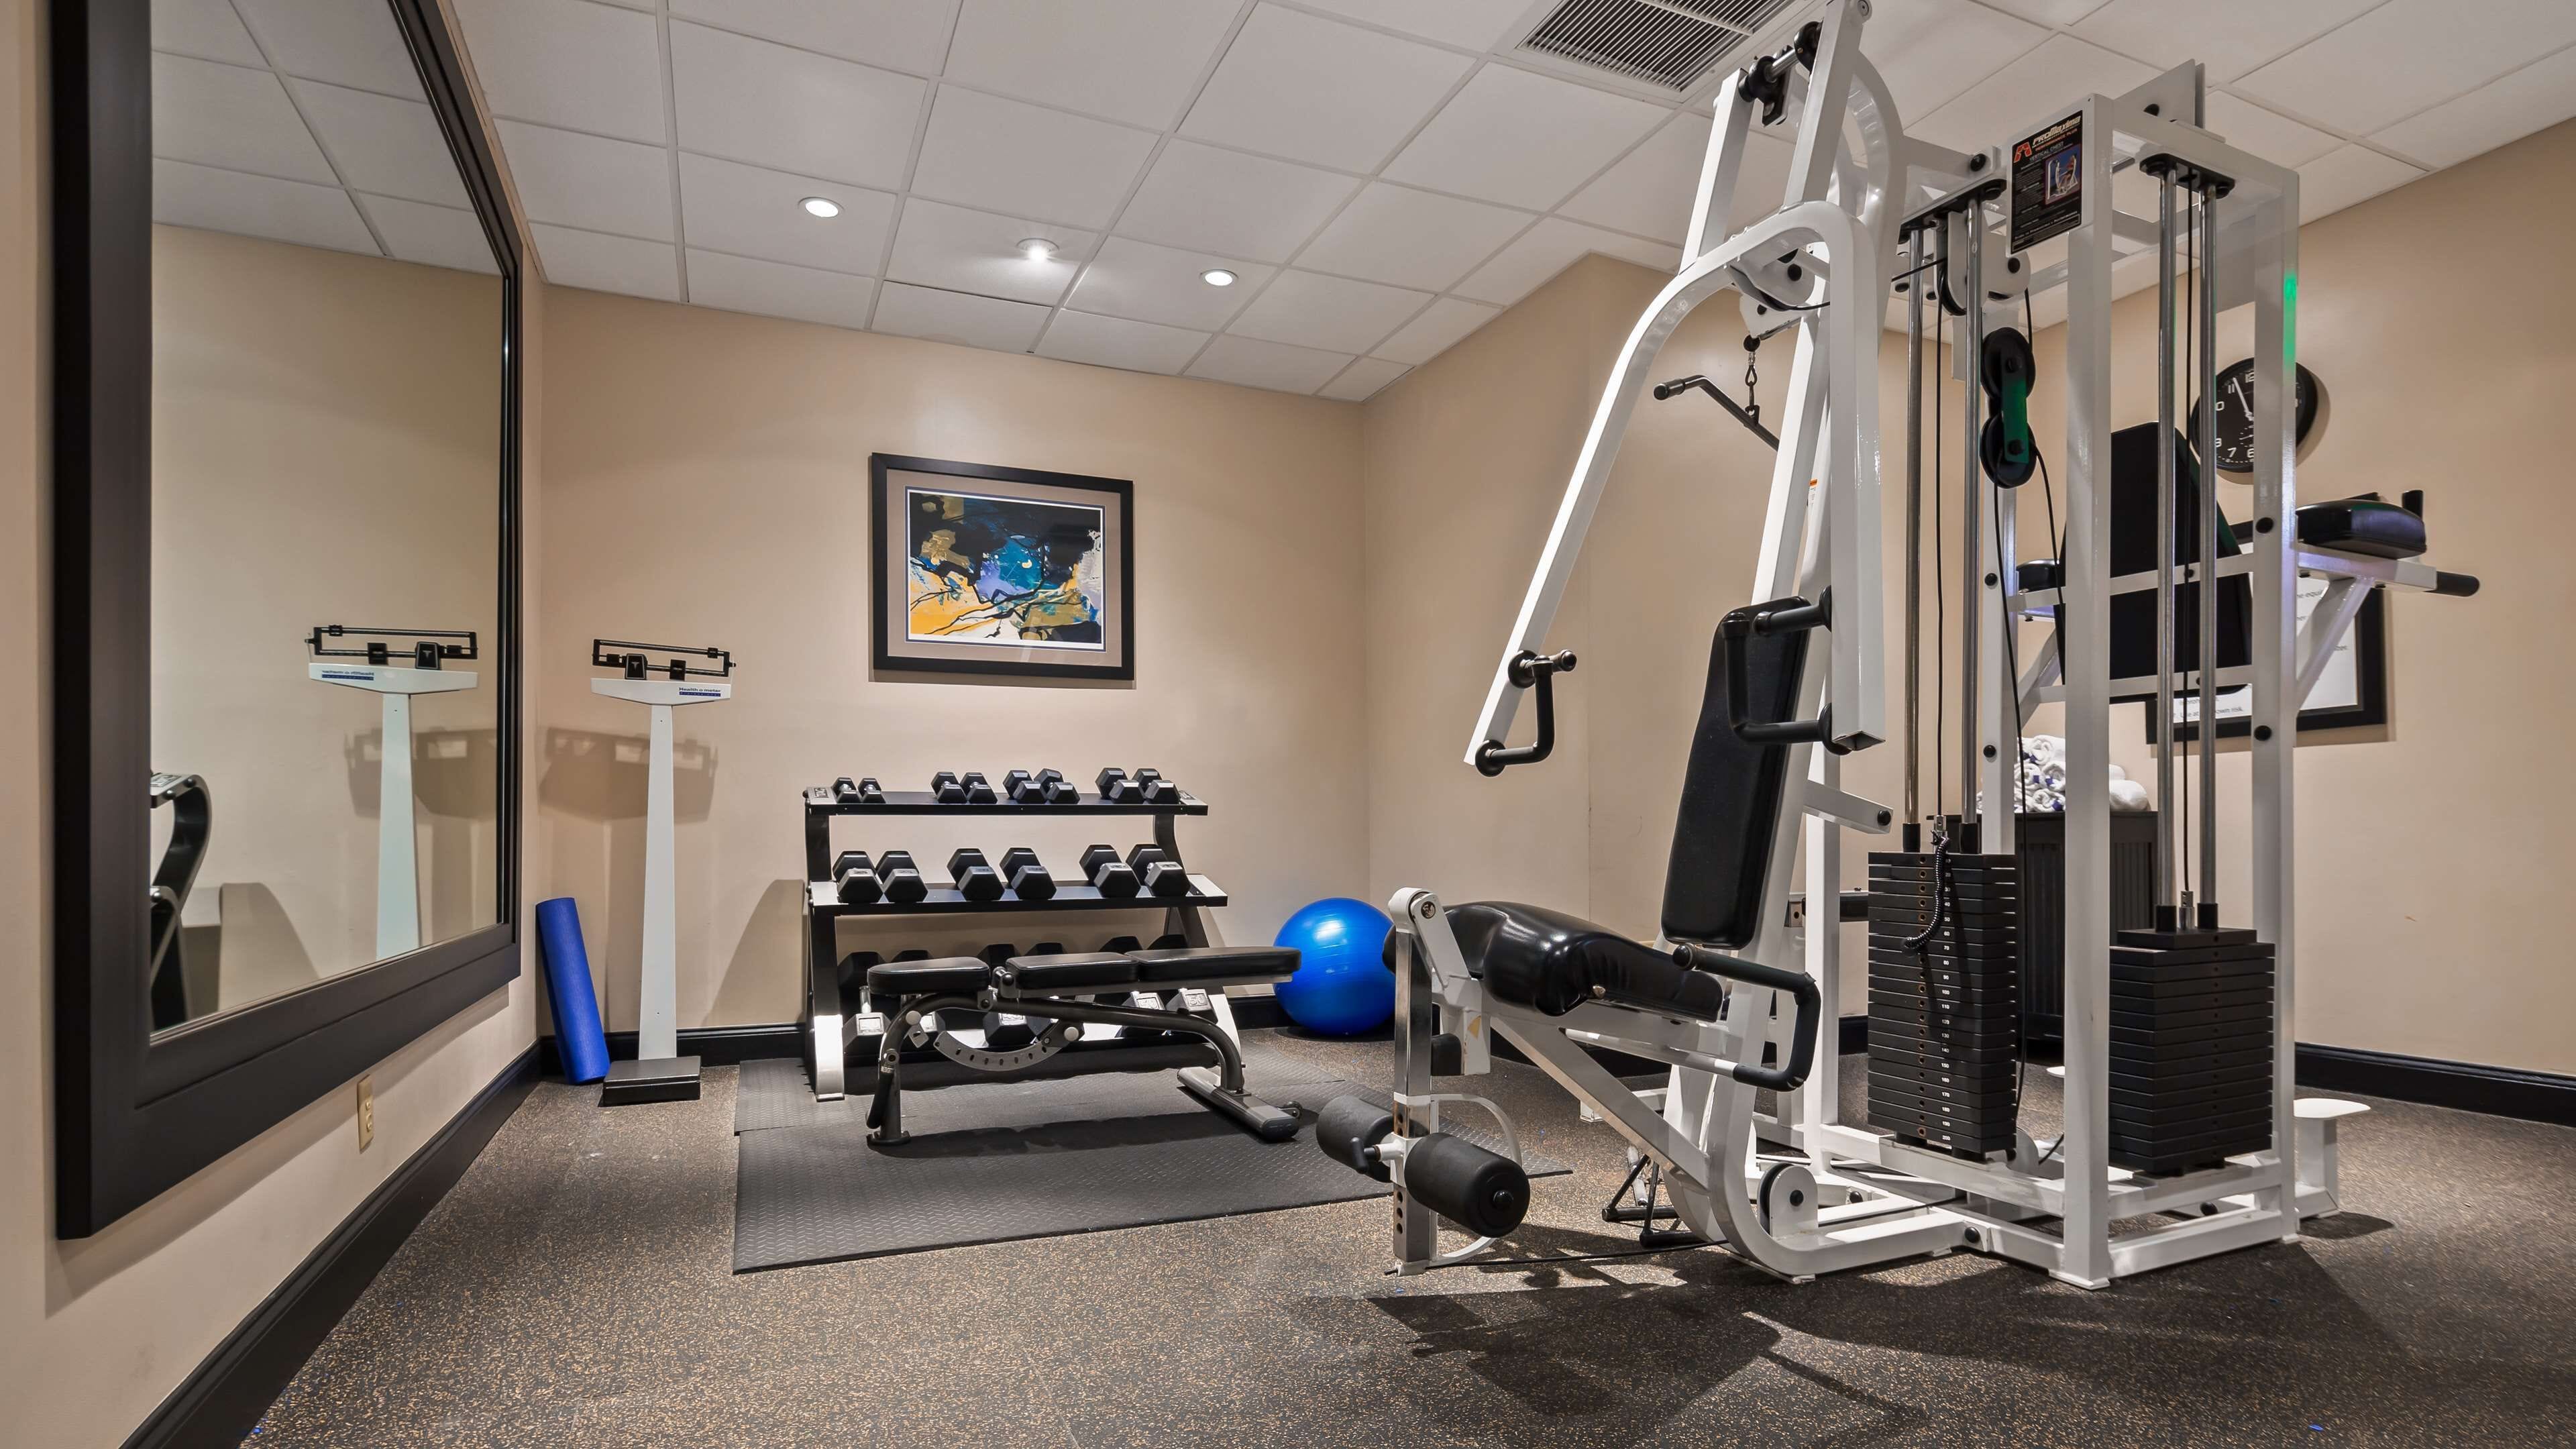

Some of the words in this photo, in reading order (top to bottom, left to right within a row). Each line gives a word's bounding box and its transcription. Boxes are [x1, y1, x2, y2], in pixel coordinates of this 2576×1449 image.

[2228, 384, 2235, 394] 11
[2216, 401, 2224, 411] 0
[2227, 447, 2237, 458] 7
